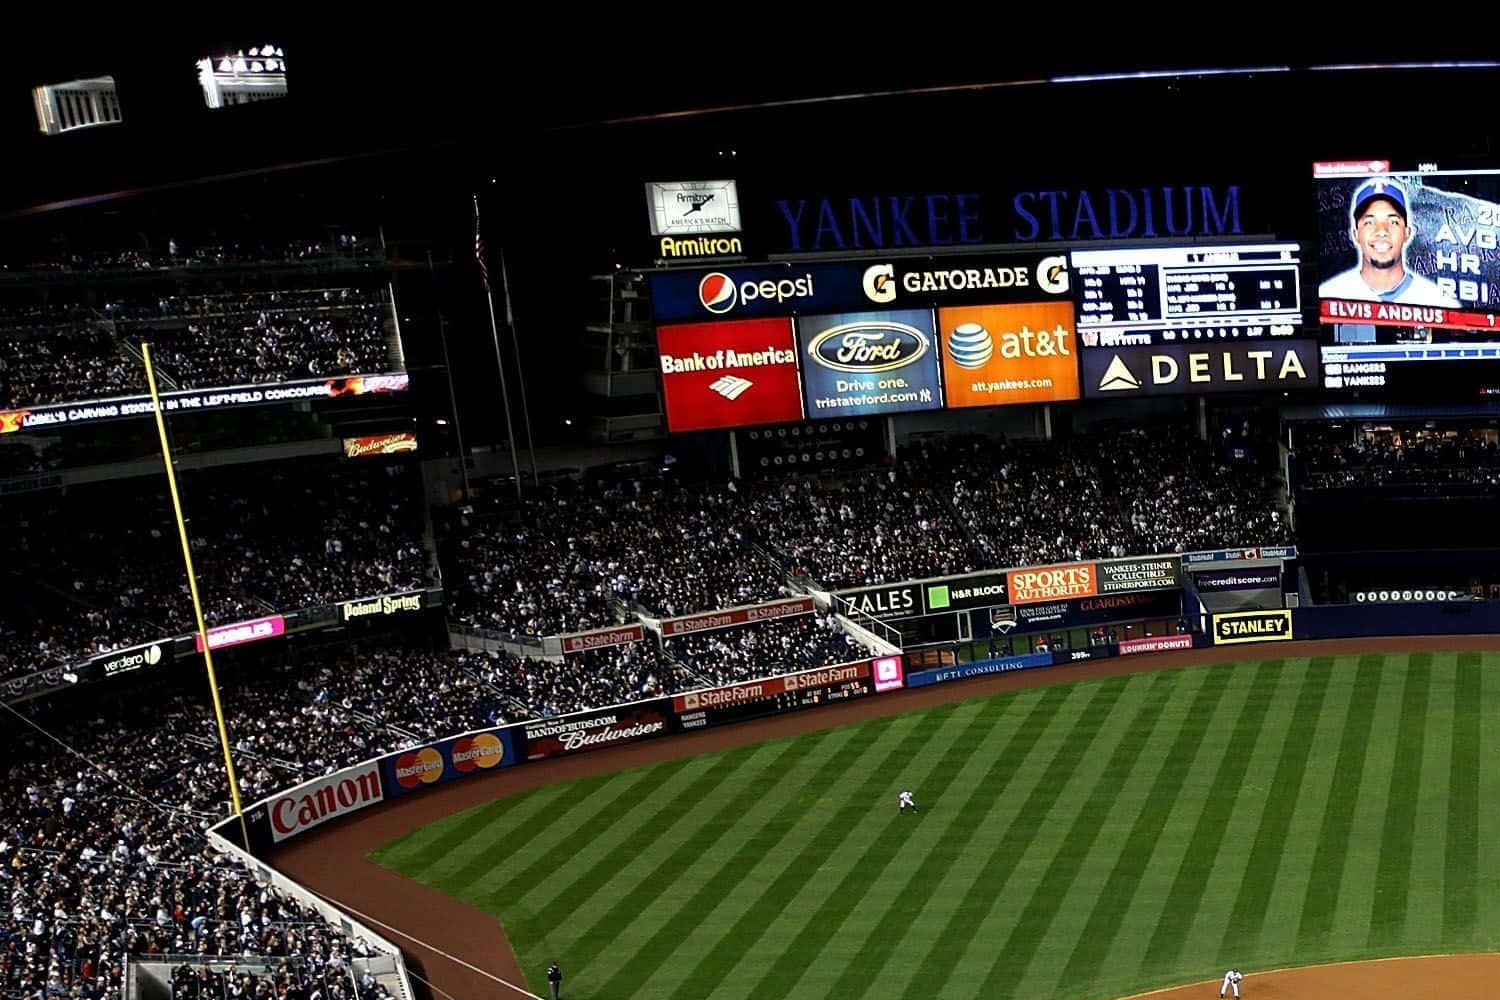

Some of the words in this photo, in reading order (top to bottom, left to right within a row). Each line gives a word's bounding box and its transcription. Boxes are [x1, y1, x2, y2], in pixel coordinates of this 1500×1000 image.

[777, 192, 982, 250] YANKEE
[1013, 184, 1243, 242] STADIUM
[661, 237, 742, 257] Armitron
[1436, 224, 1498, 250] AVG
[1437, 250, 1481, 275] HR
[740, 274, 814, 305] pepsi
[903, 267, 1029, 293] GATORADE
[1439, 278, 1489, 303] RBI
[1328, 302, 1372, 319] ELVIS
[1378, 304, 1444, 324] ANDRUS
[1486, 314, 1495, 327] 1
[836, 332, 901, 363] Ford
[1001, 325, 1070, 359] at&t
[660, 353, 705, 374] Bank
[705, 350, 725, 370] of
[725, 346, 794, 368] America
[1151, 350, 1307, 384] DELTA
[836, 380, 875, 393] Drive
[878, 378, 908, 390] one.
[971, 377, 1053, 392] att.yankees.com
[166, 399, 179, 410] IN
[180, 397, 202, 408] THE
[816, 390, 918, 409] tristateford.com
[348, 433, 408, 457] Budweiser
[1013, 567, 1090, 590] SPORTS
[1103, 578, 1175, 591] STEINERSPORTS.COM
[1111, 569, 1166, 581] COLLECTIBLES
[846, 589, 913, 616] ZALES
[951, 589, 971, 600] H&R
[973, 585, 1005, 597] BLOCK
[344, 598, 383, 621] Poland
[383, 595, 421, 616] Spring
[1221, 618, 1284, 636] STANLEY
[1157, 640, 1190, 650] DONUTS
[965, 661, 1024, 676] CONSULTING
[525, 715, 617, 739] BANDOFBUDS.COM
[558, 720, 664, 751] Budweiser
[452, 743, 503, 763] MasterCard
[396, 758, 442, 778] MasterCard
[272, 769, 381, 834] Canon
